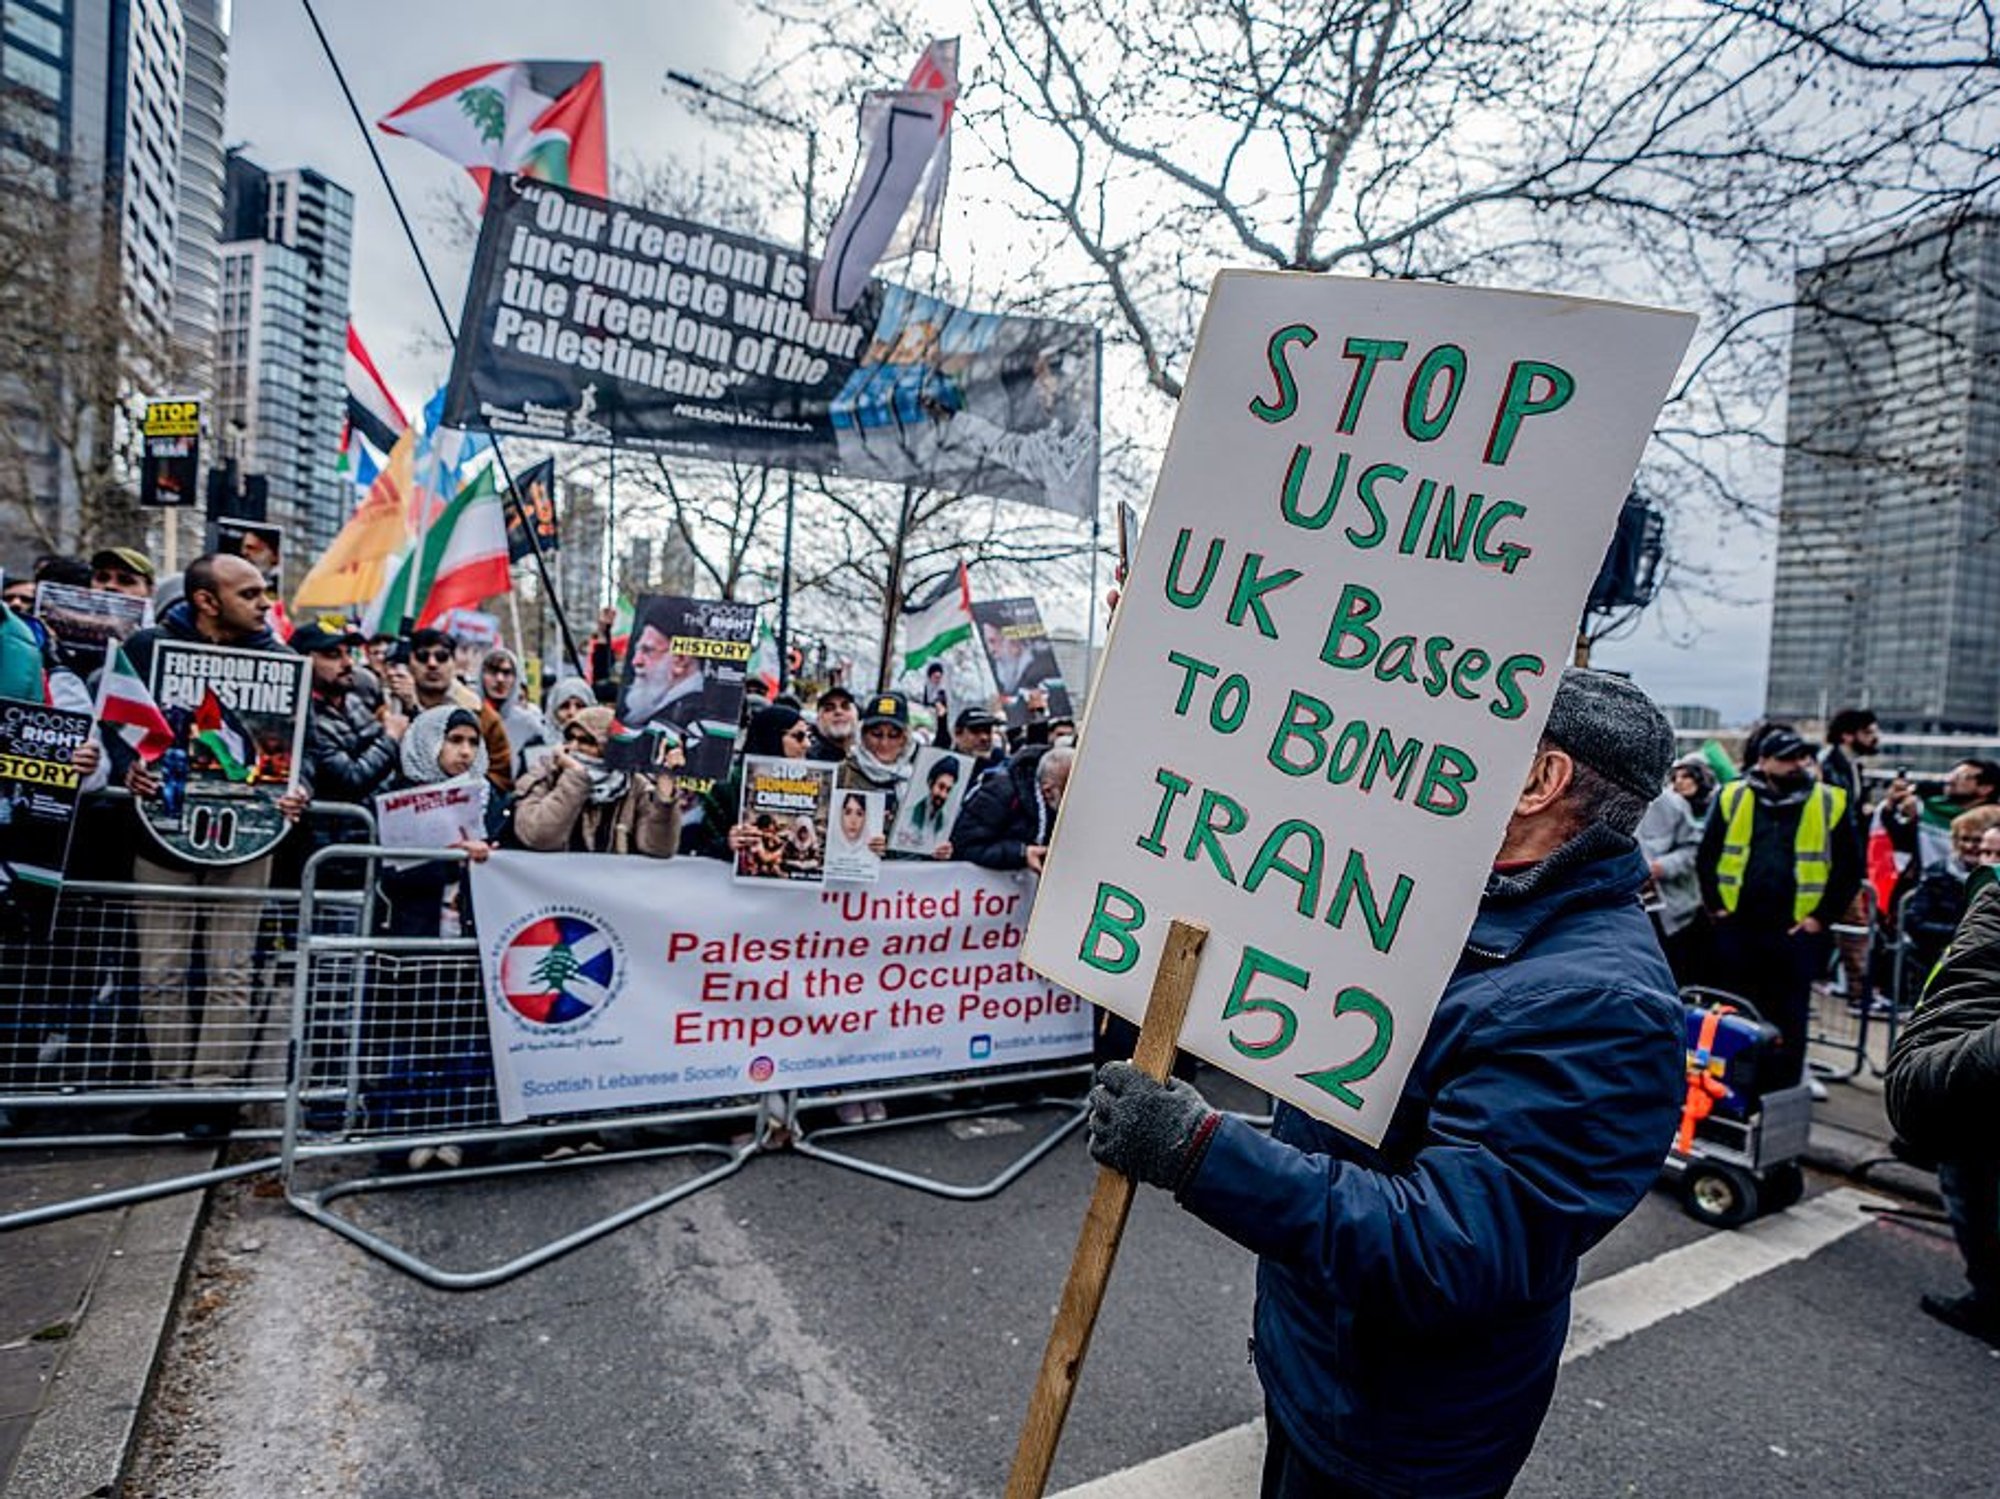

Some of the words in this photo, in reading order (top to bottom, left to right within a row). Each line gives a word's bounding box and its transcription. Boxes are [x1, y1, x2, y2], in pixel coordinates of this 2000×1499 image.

[610, 211, 768, 287] freedom
[771, 254, 807, 299] is
[509, 226, 728, 317] incomplete
[733, 289, 863, 359] without
[503, 267, 568, 317] the
[573, 285, 732, 363] freedom
[735, 335, 777, 375] of
[776, 346, 829, 386] the
[1249, 324, 1576, 466] STOP
[1280, 443, 1531, 574] USING
[1164, 527, 1303, 639] UK
[165, 651, 254, 681] FREEDOM
[258, 660, 295, 684] FOR
[672, 640, 747, 658] HISTORY
[5, 707, 88, 733] CHOOSE
[22, 726, 85, 748] RIGHT
[1167, 650, 1251, 734] TO
[1268, 689, 1478, 821] BOMB
[1136, 768, 1415, 954] IRAN
[821, 892, 959, 921] "United
[973, 892, 1019, 916] for
[667, 931, 869, 963] Palestine
[883, 926, 952, 955] and
[962, 925, 1021, 950] Leb
[702, 970, 789, 1002] End
[804, 968, 864, 998] the
[879, 961, 1052, 991] Occupati
[1078, 881, 1146, 974] B
[1221, 945, 1395, 1110] 52
[674, 1004, 878, 1046] Empower
[890, 1000, 944, 1028] the
[522, 1075, 592, 1097] Scottish
[598, 1070, 679, 1090] Lebanese
[684, 1064, 741, 1083] Society
